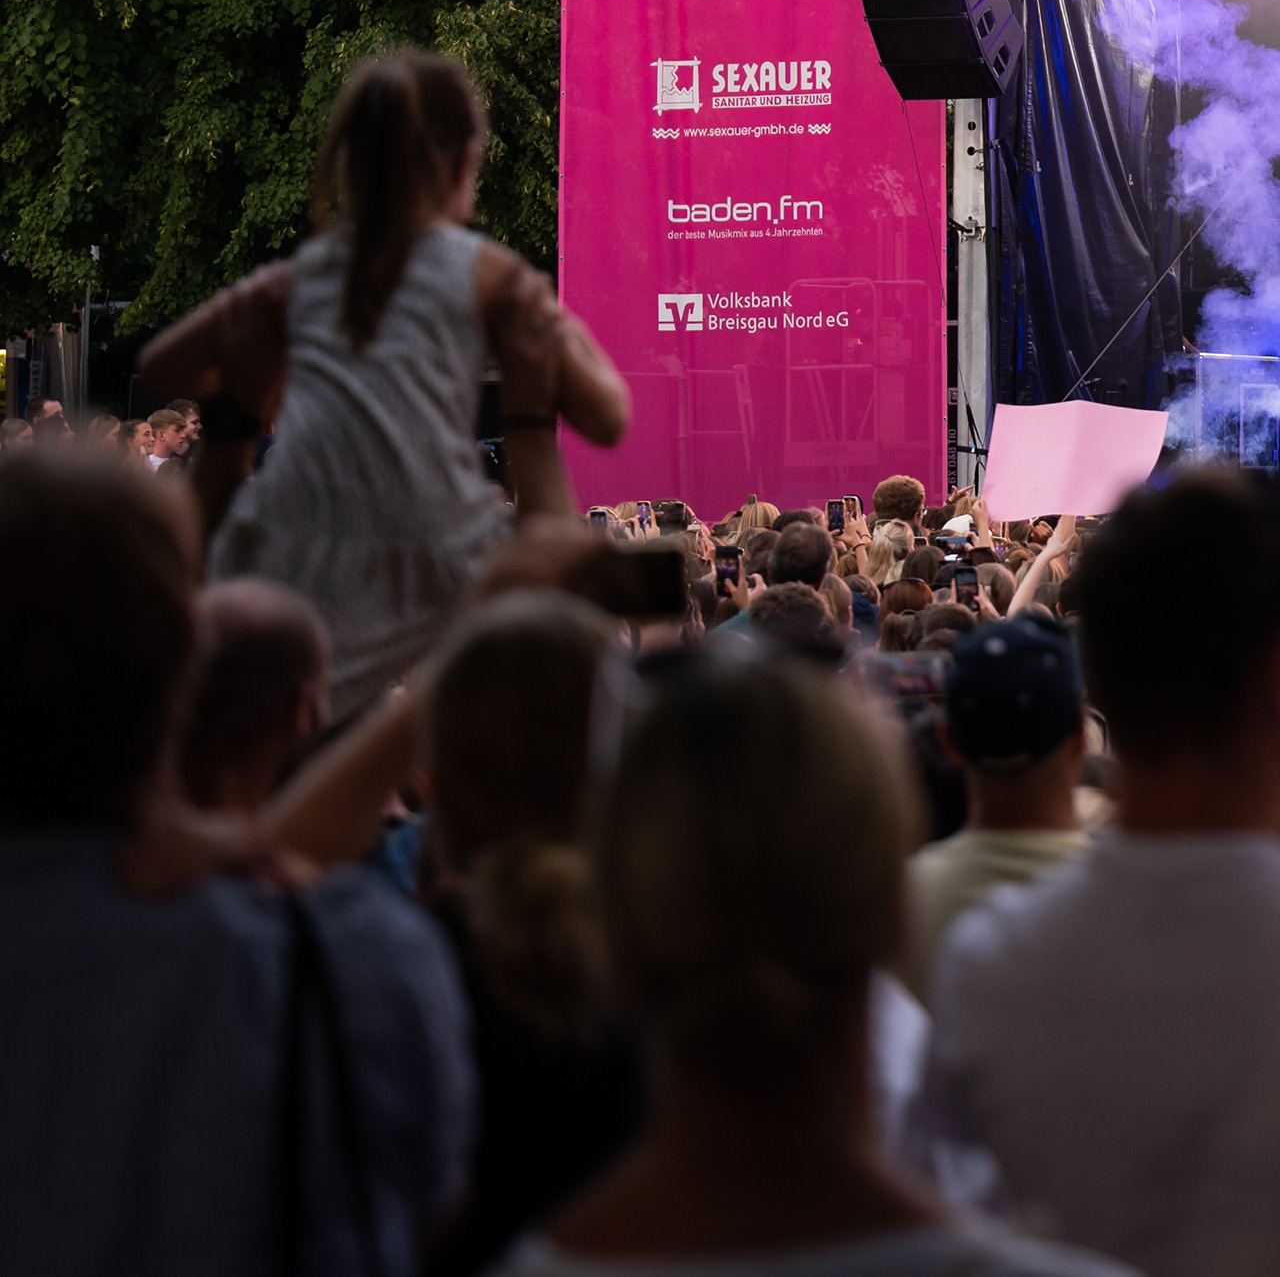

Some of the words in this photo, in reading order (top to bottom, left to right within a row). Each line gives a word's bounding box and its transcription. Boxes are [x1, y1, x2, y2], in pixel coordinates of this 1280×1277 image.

[712, 59, 832, 93] SEXAUER
[760, 96, 782, 106] UND
[786, 94, 830, 105] HEIZUNG
[683, 123, 805, 138] www.sexauer-gmbh.de
[667, 194, 824, 225] baden.fm
[667, 229, 683, 240] der
[685, 230, 706, 240] beste
[707, 228, 748, 239] Musikmix
[749, 229, 764, 238] aus
[765, 228, 771, 237] 4
[771, 226, 824, 237] Jahrzehnten
[707, 291, 793, 309] Volksbank
[708, 314, 778, 333] Breisgau
[782, 311, 823, 329] Nord
[825, 311, 849, 328] eG
